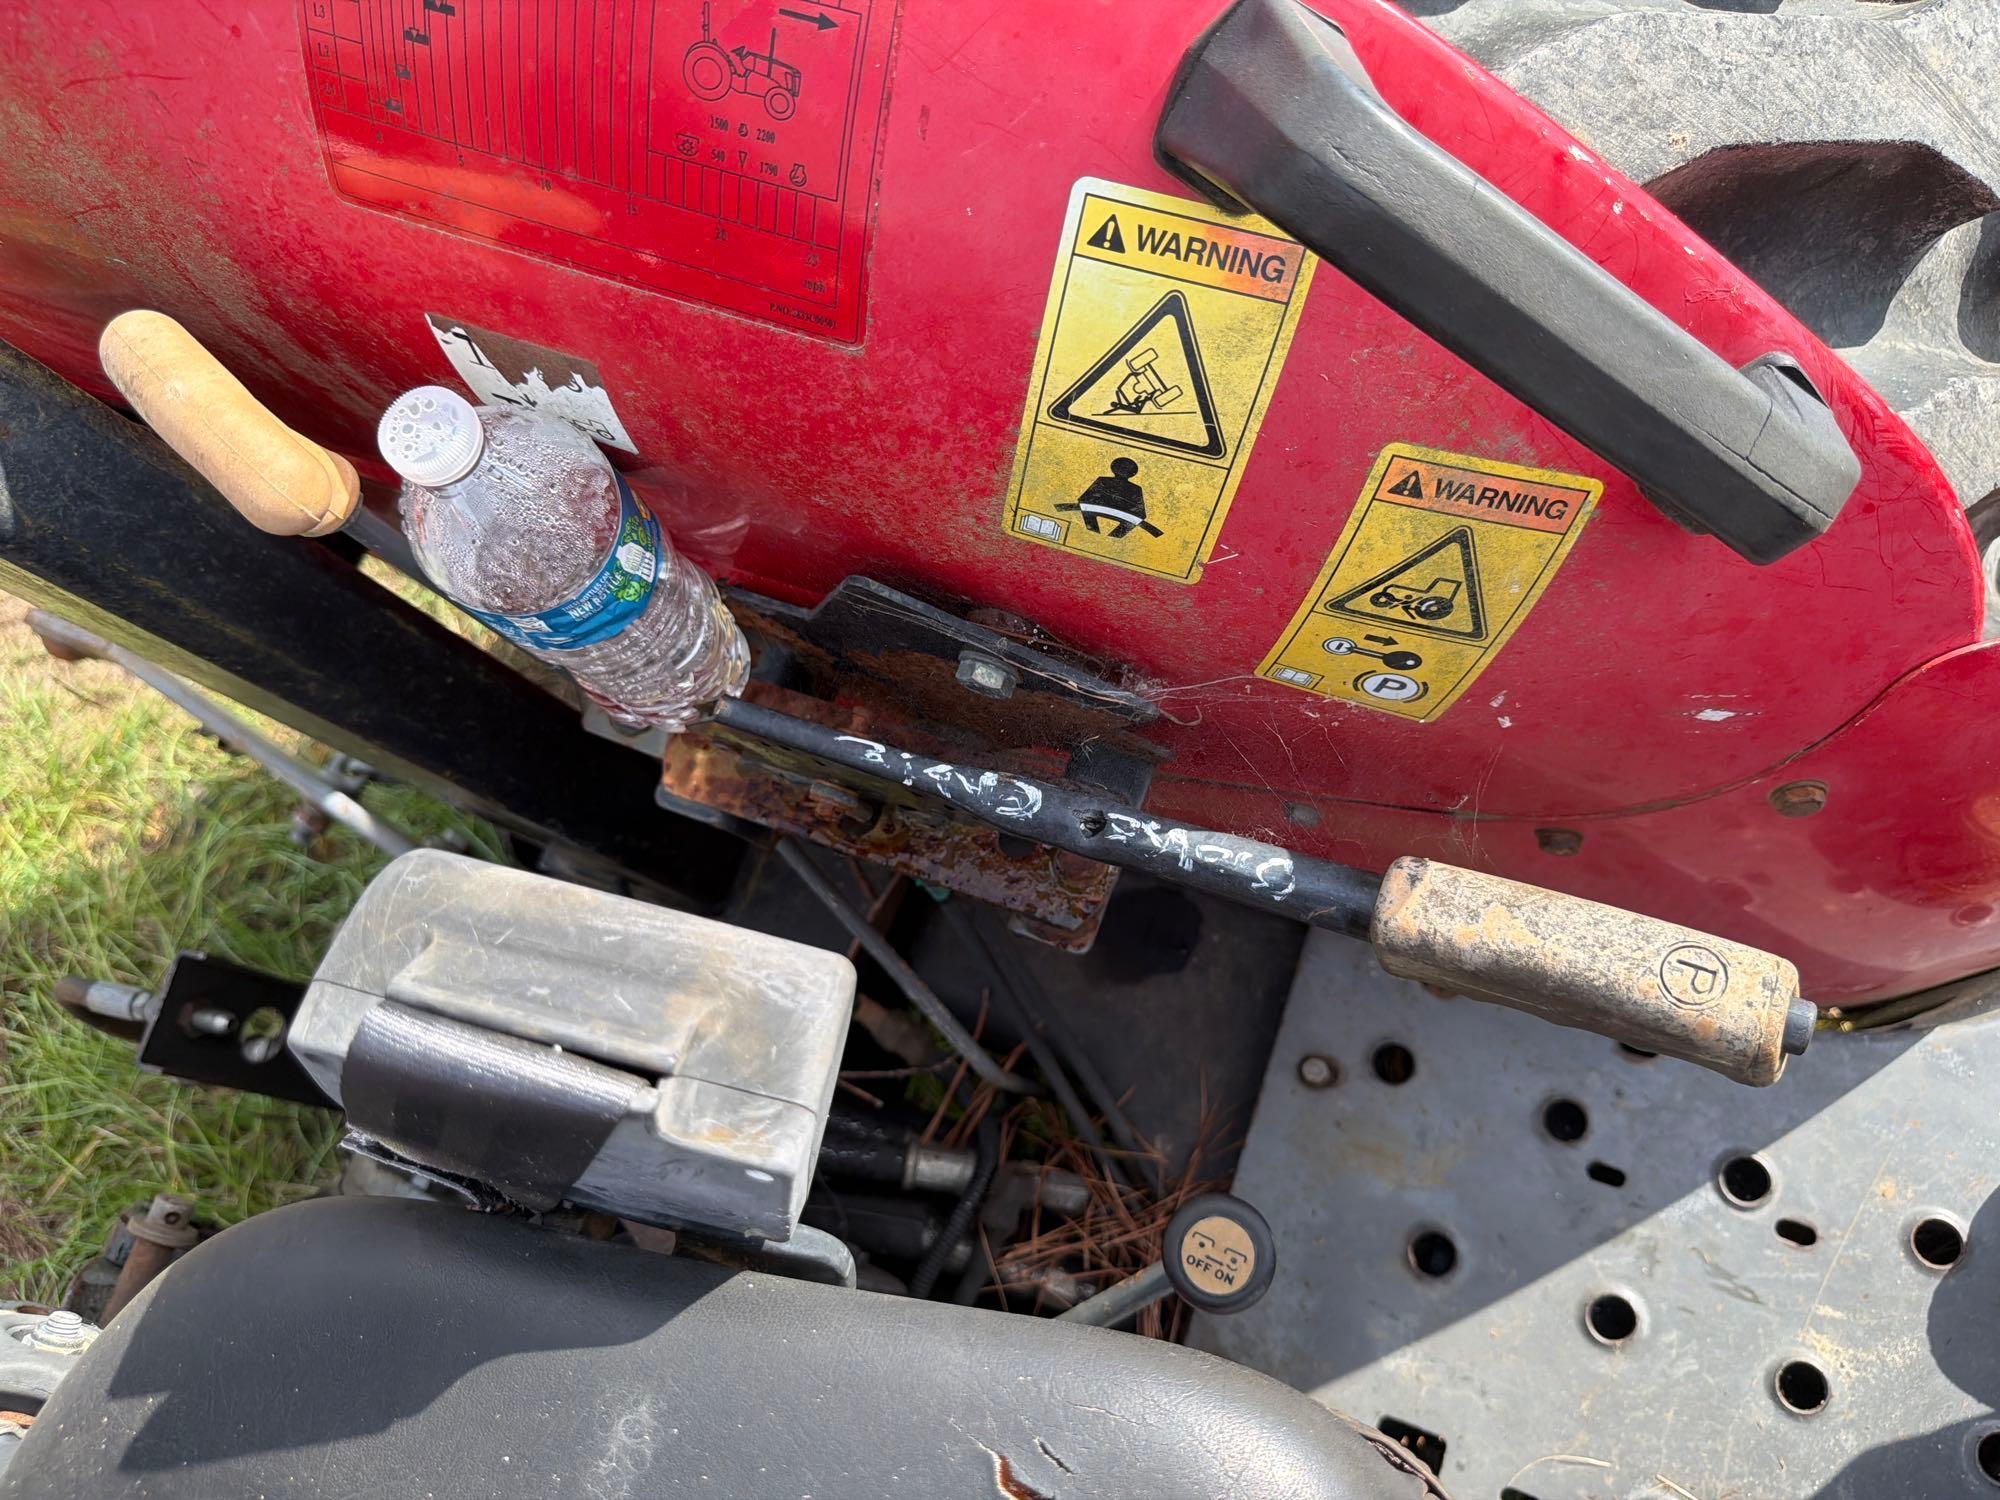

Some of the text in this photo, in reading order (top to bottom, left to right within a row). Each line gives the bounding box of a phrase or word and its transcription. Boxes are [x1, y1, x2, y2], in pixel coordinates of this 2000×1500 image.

[313, 2, 325, 19] L3
[318, 42, 330, 58] L2
[756, 128, 776, 144] 2200
[458, 154, 465, 168] 5
[711, 148, 726, 162] 540
[1136, 223, 1287, 284] WARNING
[1434, 477, 1569, 521] WARNING
[567, 601, 594, 620] NEW
[592, 571, 624, 608] BOTTLE
[1373, 677, 1408, 694] P
[1676, 958, 1718, 995] P
[1186, 1254, 1235, 1285] OFF ON
